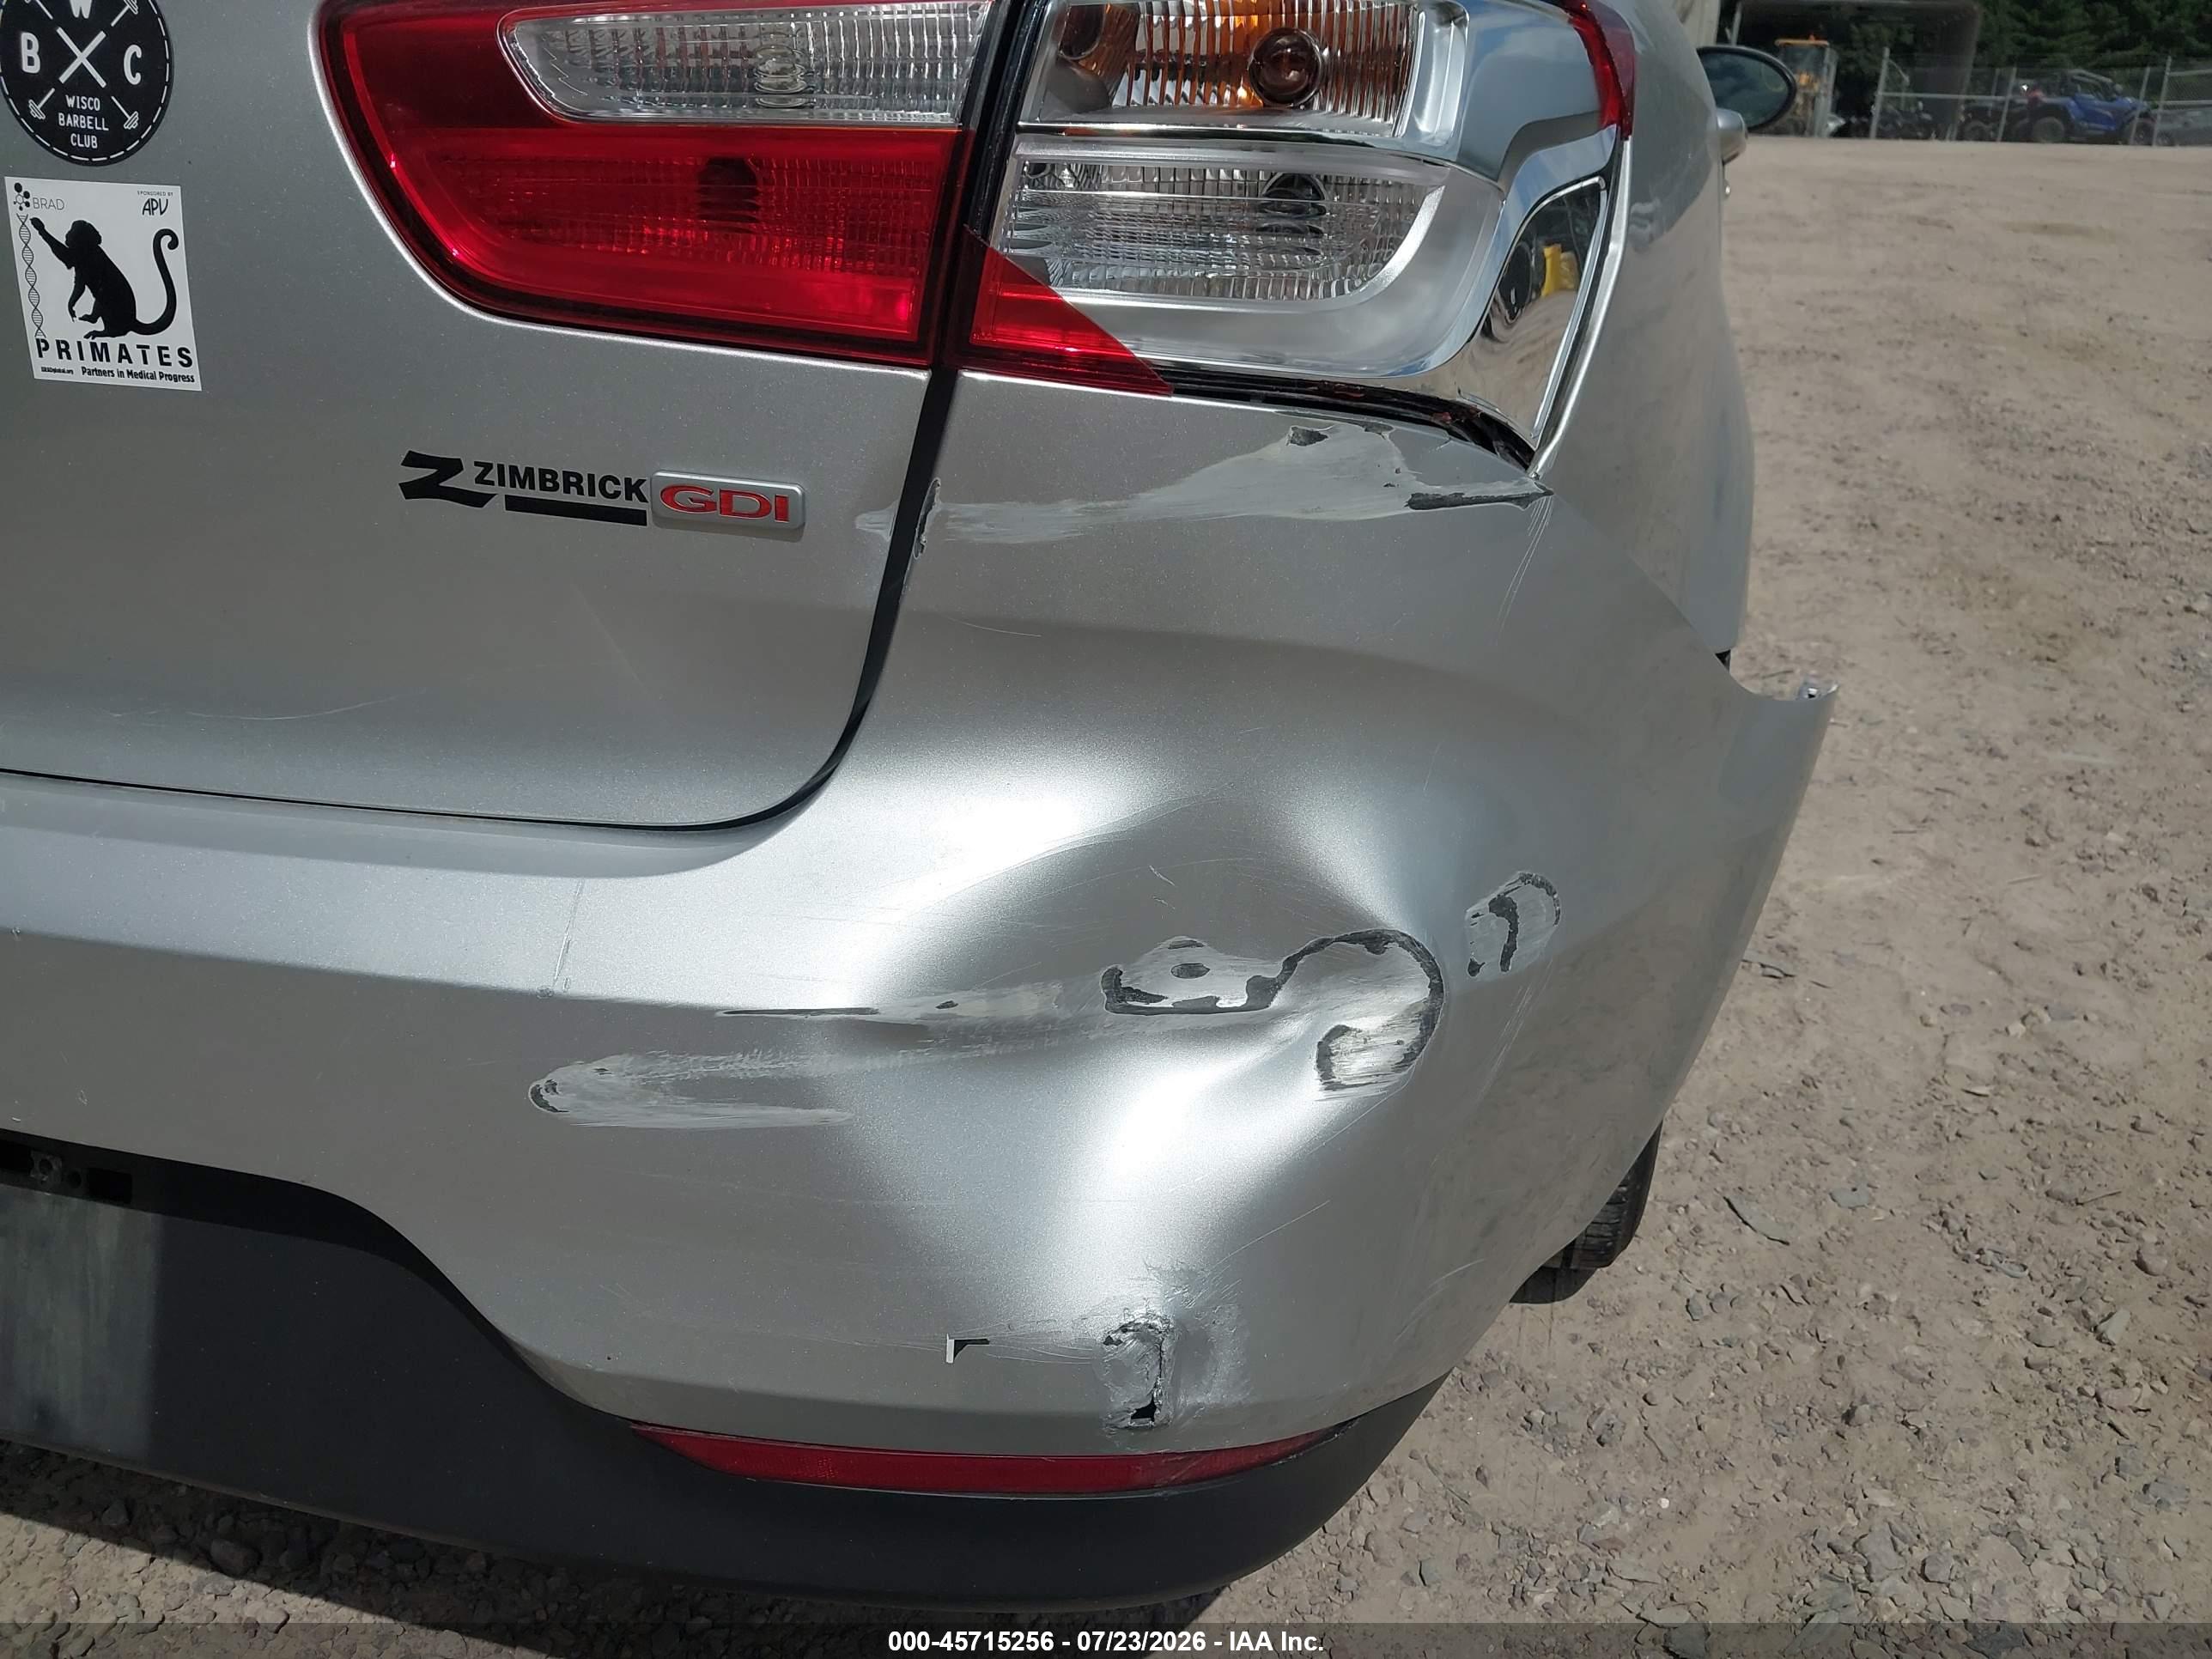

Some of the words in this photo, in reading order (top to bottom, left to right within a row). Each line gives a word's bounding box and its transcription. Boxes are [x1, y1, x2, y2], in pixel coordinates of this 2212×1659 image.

[21, 32, 40, 74] B
[124, 45, 142, 85] C
[65, 94, 100, 111] WISCO
[58, 112, 109, 131] BARBELL
[70, 133, 98, 149] CLUB
[33, 197, 64, 210] BRAD
[142, 198, 168, 216] APV
[35, 338, 193, 368] PRIMATES
[81, 366, 115, 378] Partners
[117, 368, 125, 379] in
[126, 369, 156, 380] Medical
[158, 371, 195, 383] Progress
[473, 461, 648, 503] ZIMBRICK
[659, 484, 789, 523] GDI
